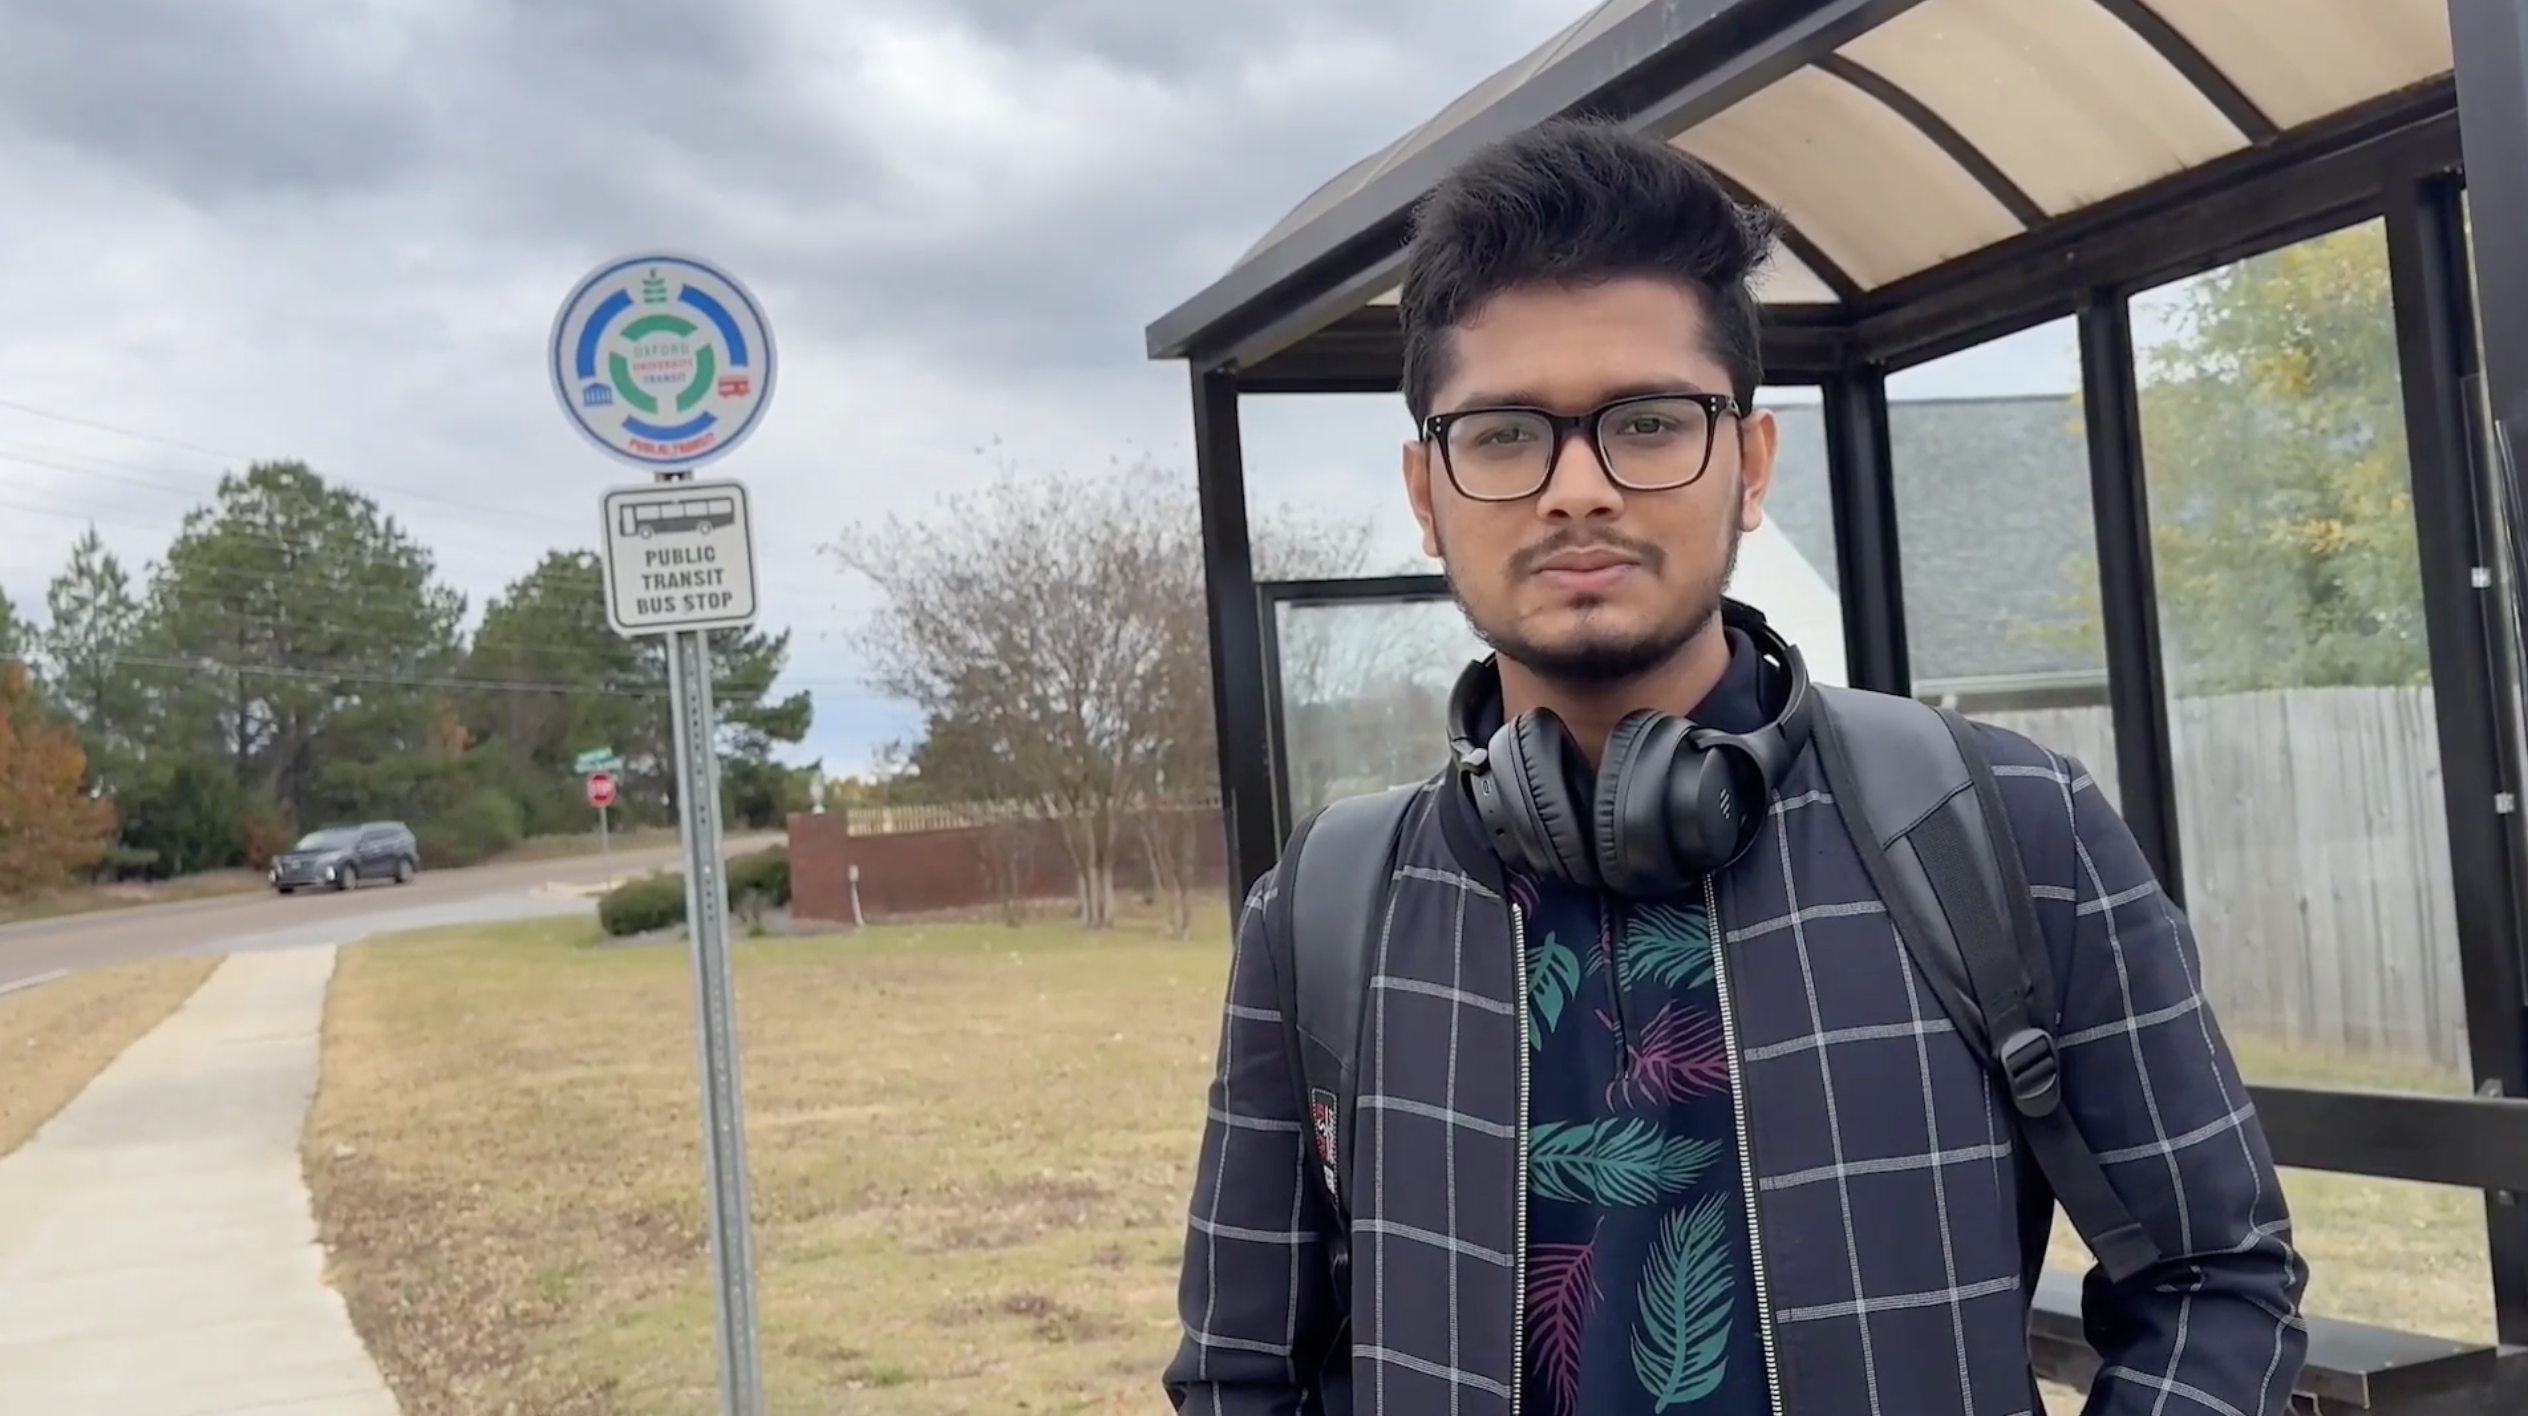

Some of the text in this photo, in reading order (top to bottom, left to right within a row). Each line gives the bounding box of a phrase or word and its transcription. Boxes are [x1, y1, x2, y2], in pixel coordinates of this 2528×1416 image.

[634, 344, 690, 358] OXFORD
[632, 358, 693, 371] UNIVERSITY
[644, 372, 686, 384] TRANSIT
[630, 432, 714, 455] PUBLIC TRANSIT
[645, 546, 716, 567] PUBLIC
[641, 568, 724, 591] TRANSIT
[636, 591, 733, 615] BUS STOP
